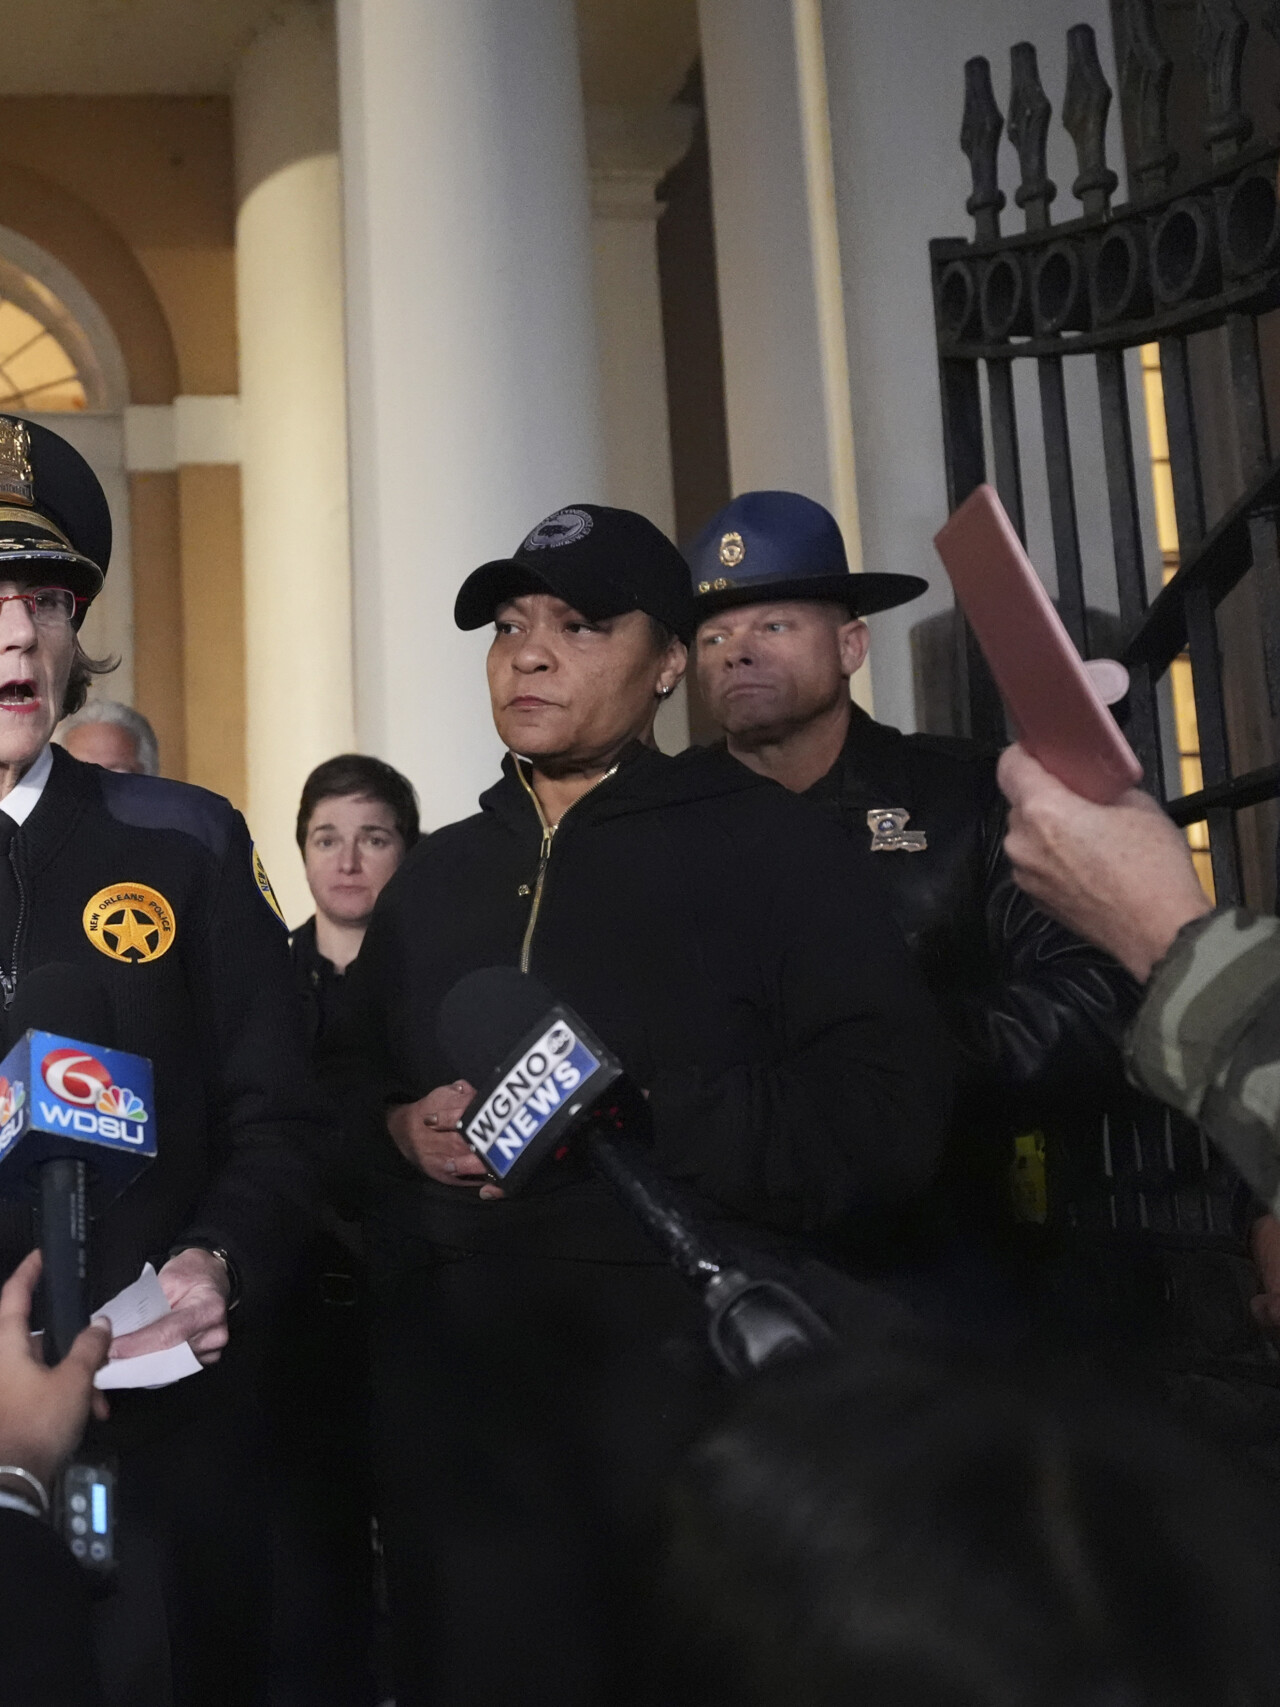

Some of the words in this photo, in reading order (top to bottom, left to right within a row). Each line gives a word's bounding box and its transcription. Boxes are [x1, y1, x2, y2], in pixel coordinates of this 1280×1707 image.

[89, 912, 101, 931] NEW
[98, 893, 145, 911] ORLEANS
[148, 900, 171, 933] POLICE
[38, 1101, 145, 1145] WDSU
[471, 1052, 548, 1142] WGNO
[495, 1060, 581, 1159] NEWS
